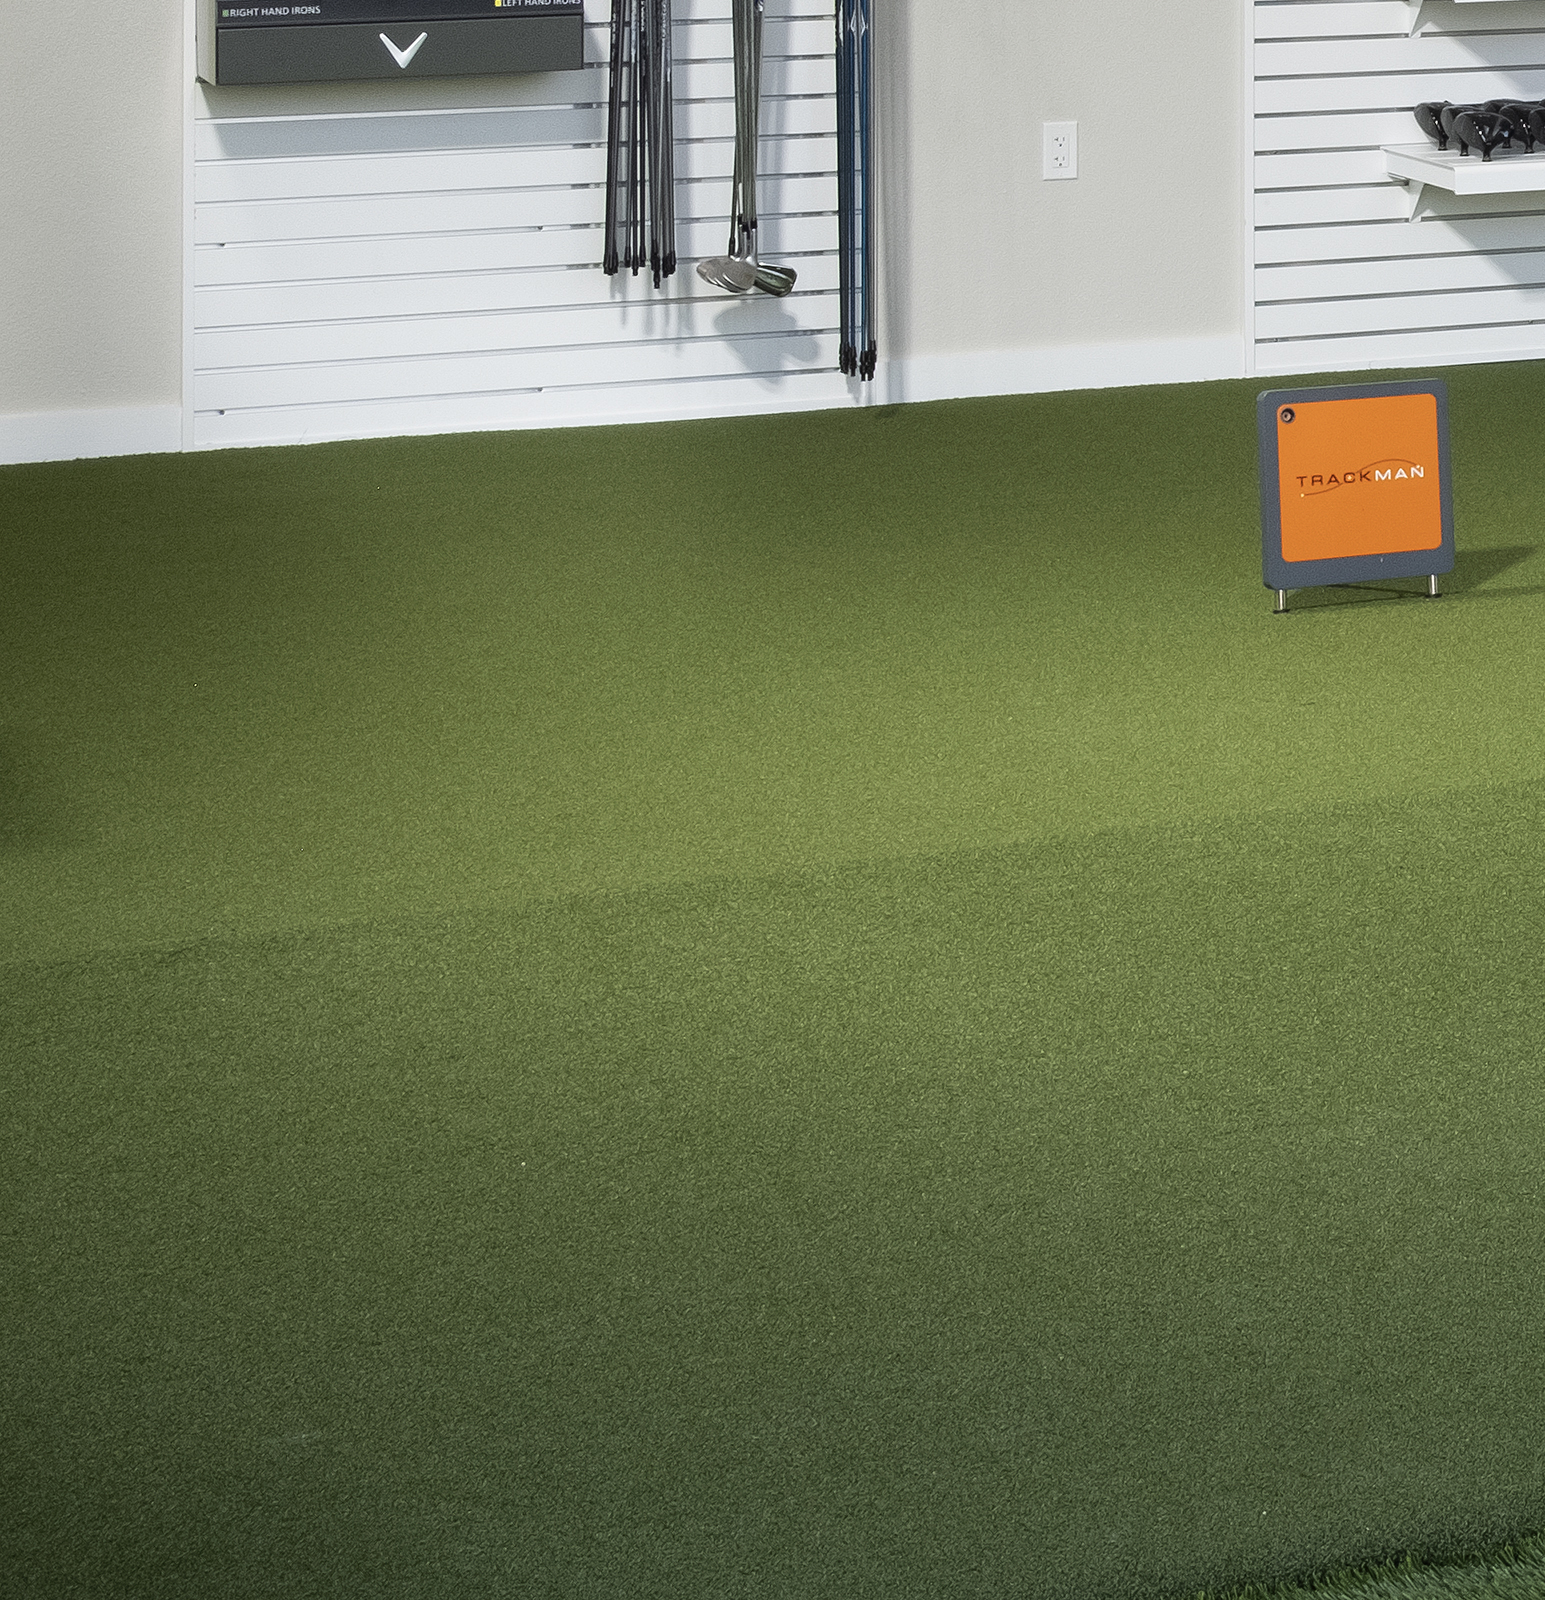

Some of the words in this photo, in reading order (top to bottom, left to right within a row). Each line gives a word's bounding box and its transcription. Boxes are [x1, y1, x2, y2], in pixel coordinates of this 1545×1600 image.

[229, 7, 260, 17] RIGHT
[261, 6, 290, 16] HAND
[291, 5, 321, 15] IRONS
[1296, 465, 1425, 488] TRACKMAN
